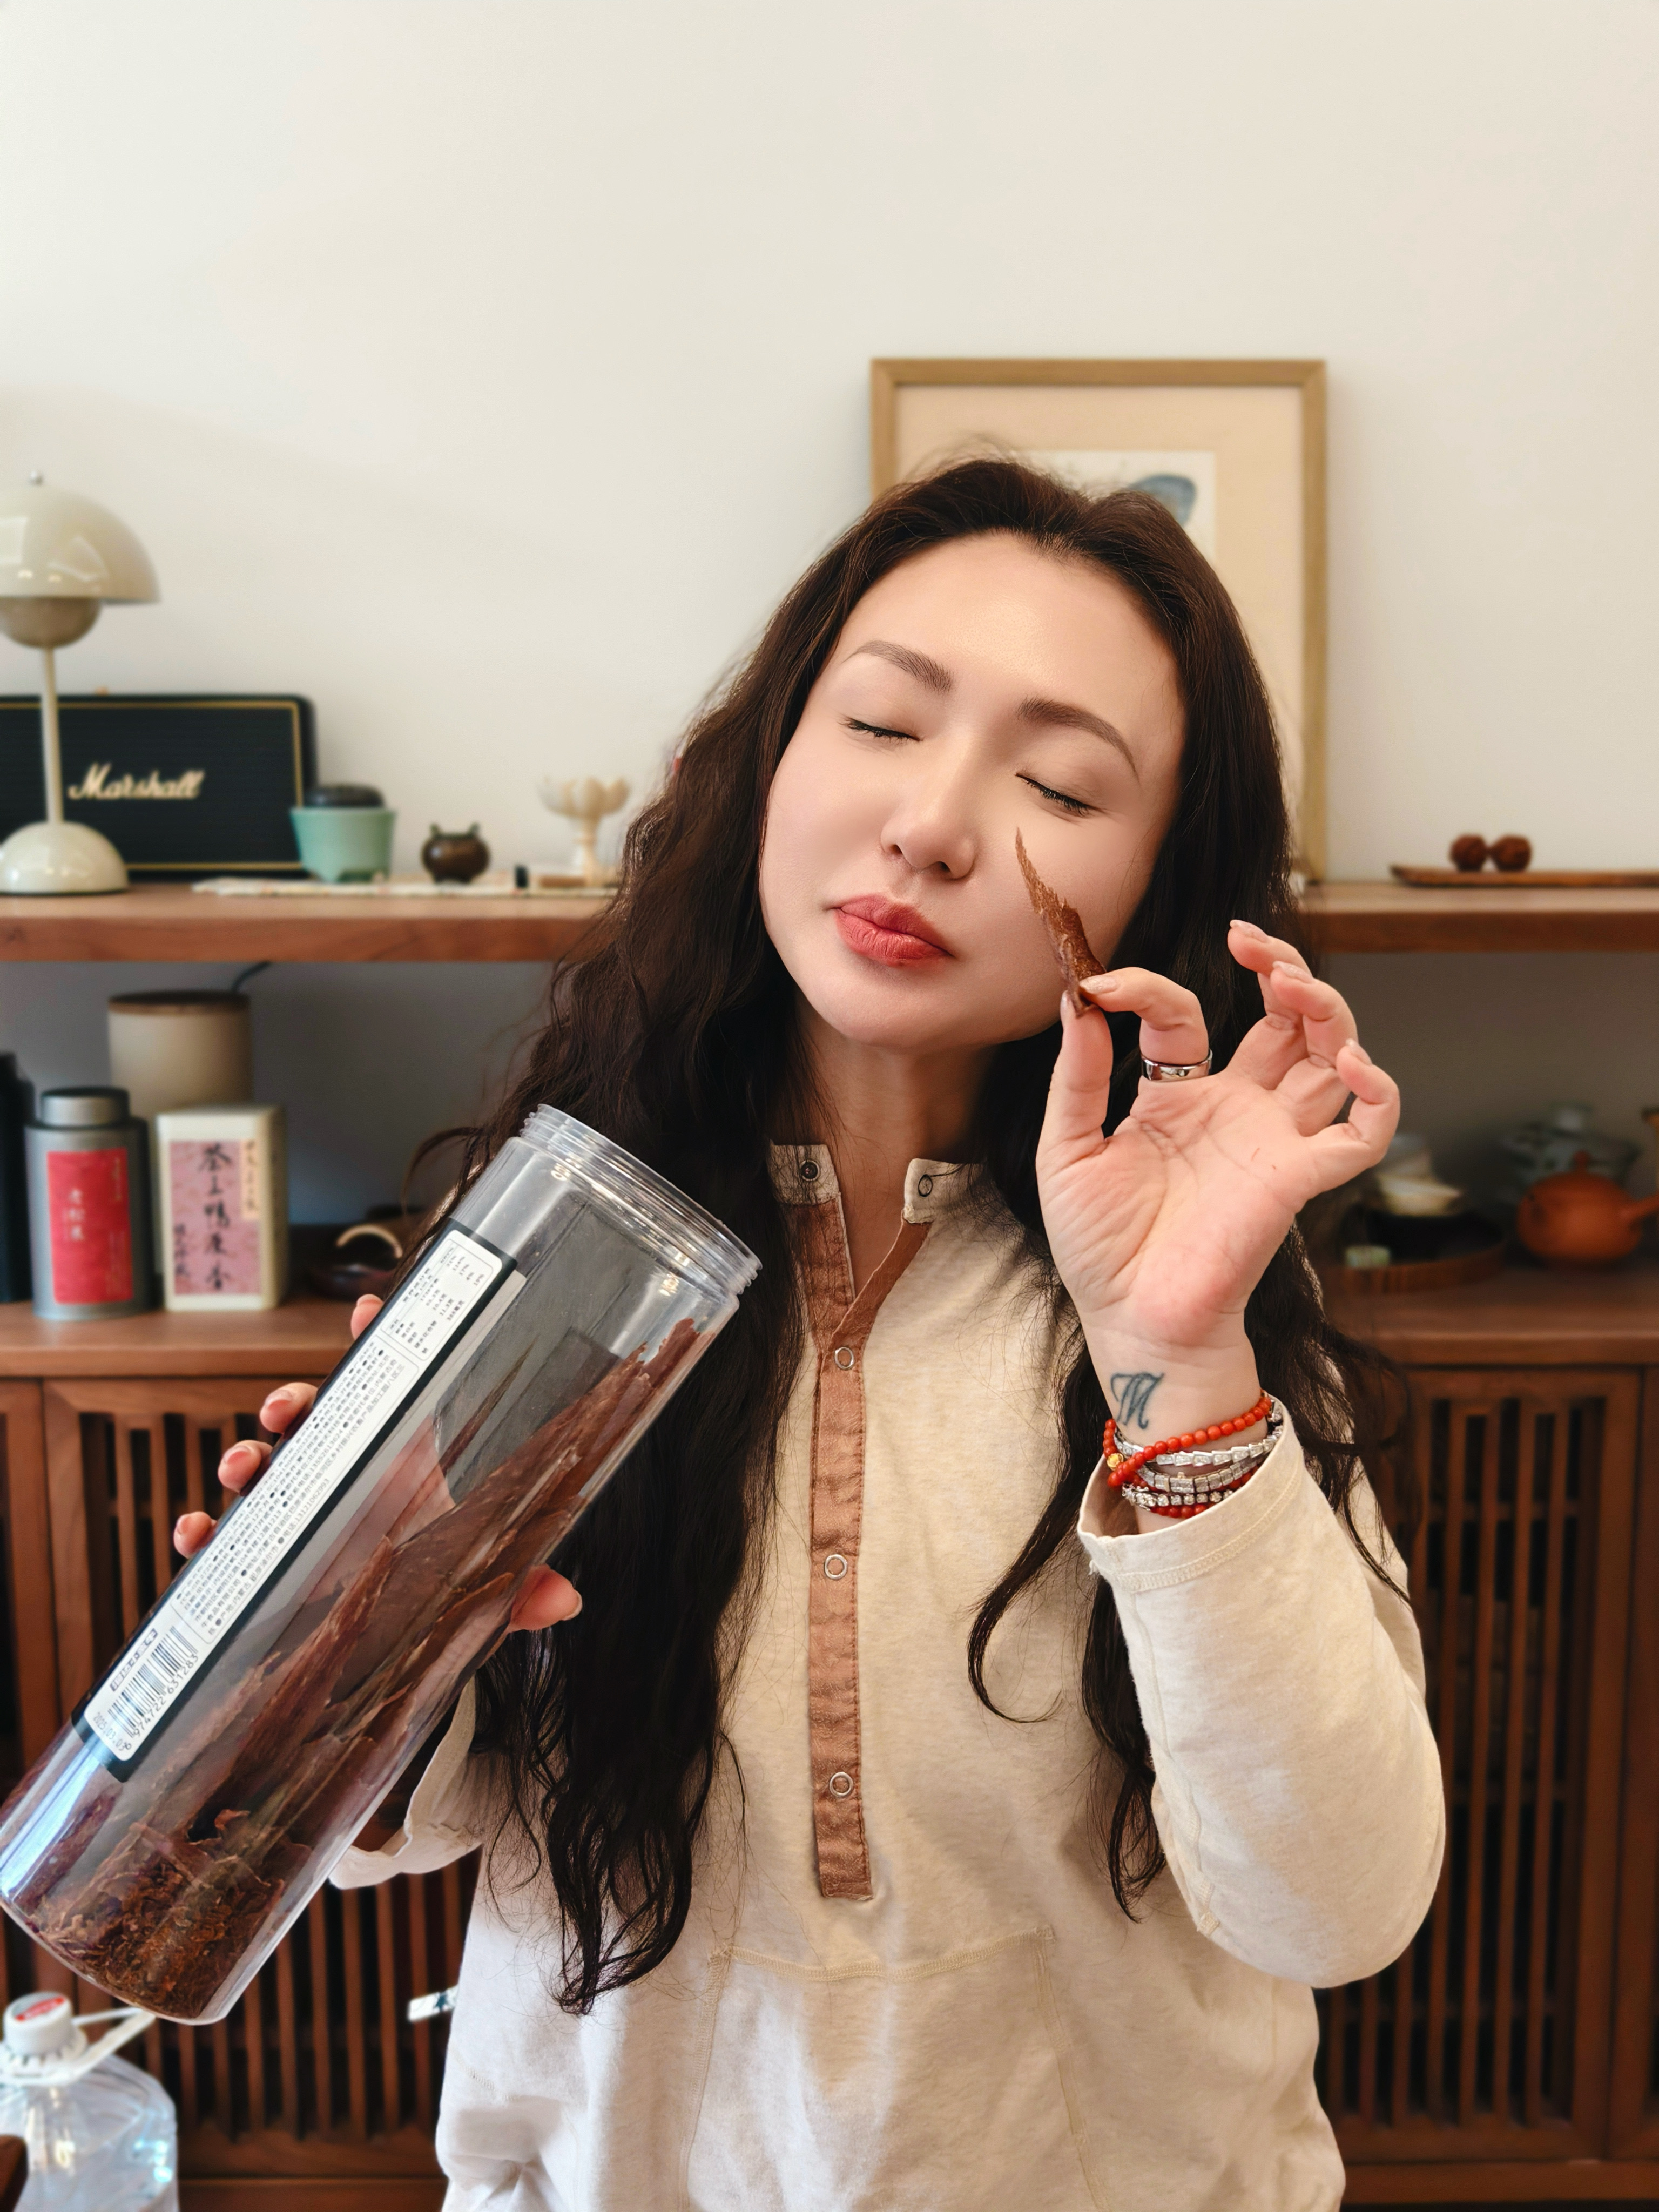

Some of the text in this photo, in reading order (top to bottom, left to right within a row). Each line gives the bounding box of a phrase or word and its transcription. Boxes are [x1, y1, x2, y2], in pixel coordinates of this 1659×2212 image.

[68, 763, 205, 800] Marshall
[440, 1246, 454, 1264] NRV%
[132, 1695, 167, 1738] 974722
[164, 1652, 200, 1695] 631283
